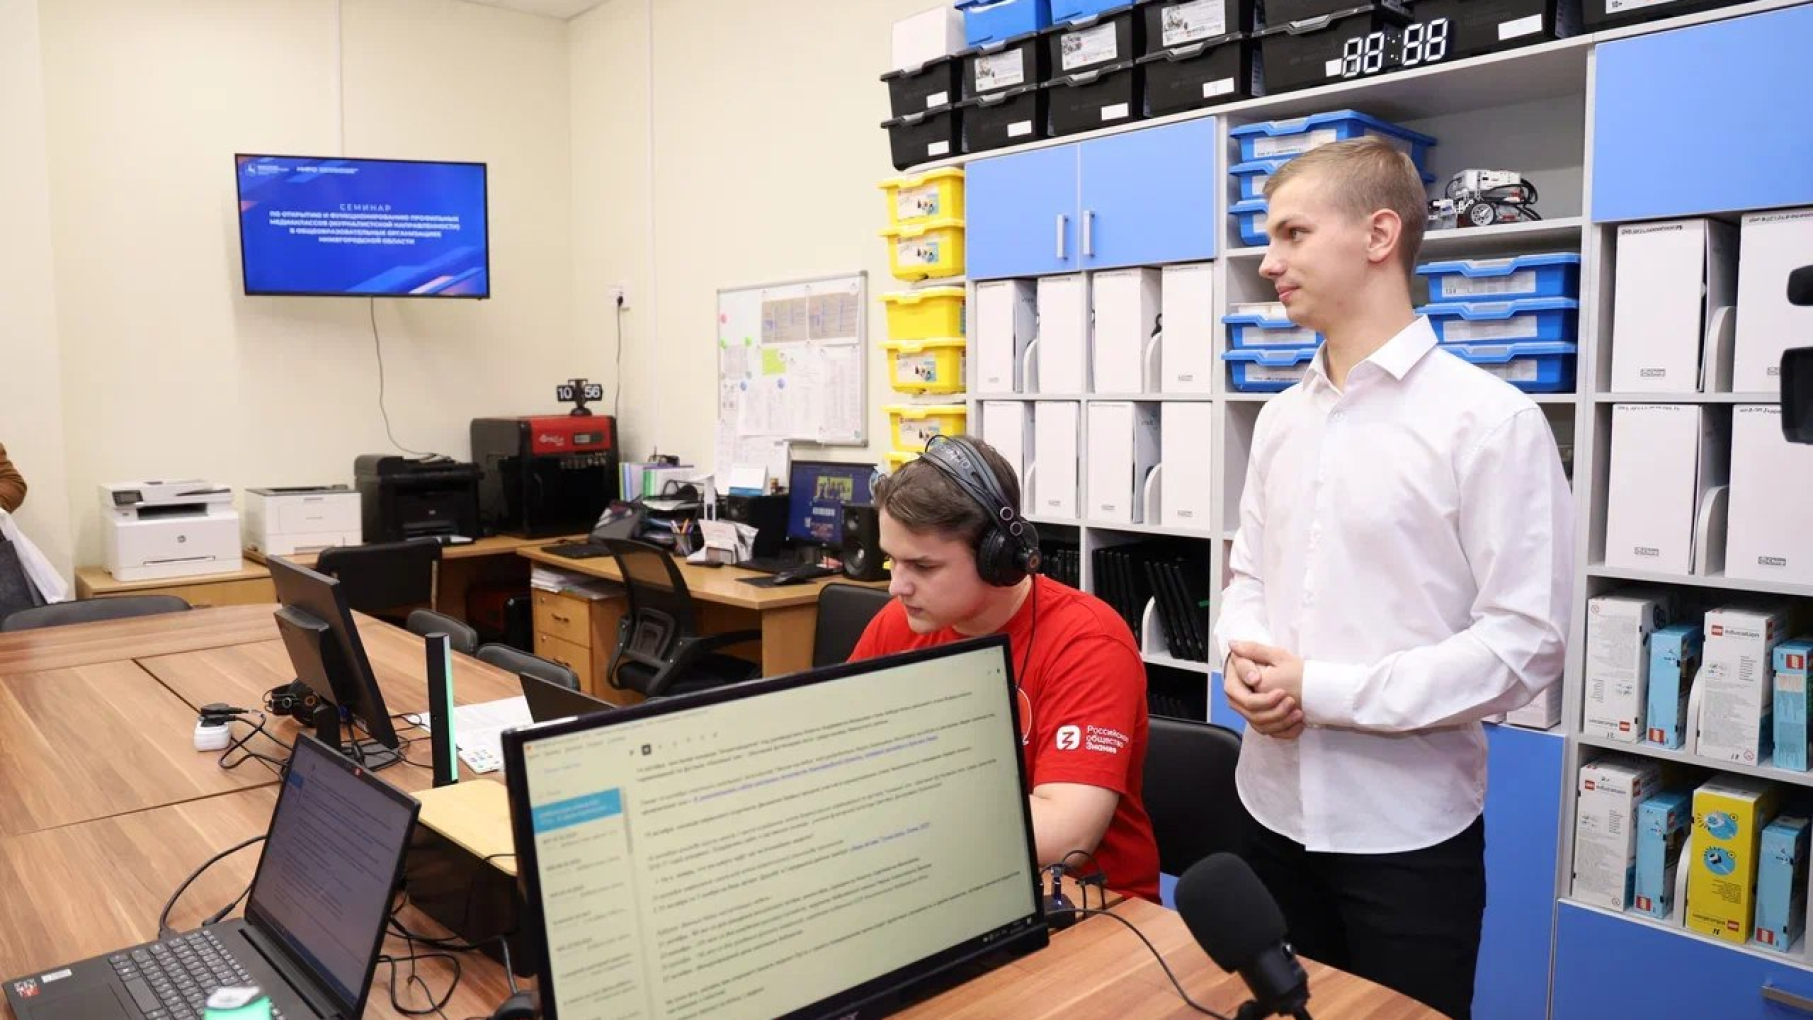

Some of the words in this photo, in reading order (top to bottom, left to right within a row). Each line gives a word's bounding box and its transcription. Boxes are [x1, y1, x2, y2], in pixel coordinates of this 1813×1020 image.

[340, 203, 392, 212] СЕМИНАР
[558, 387, 572, 399] 10
[585, 386, 600, 398] 56
[1087, 725, 1129, 742] Российско
[1085, 741, 1117, 754] Знание
